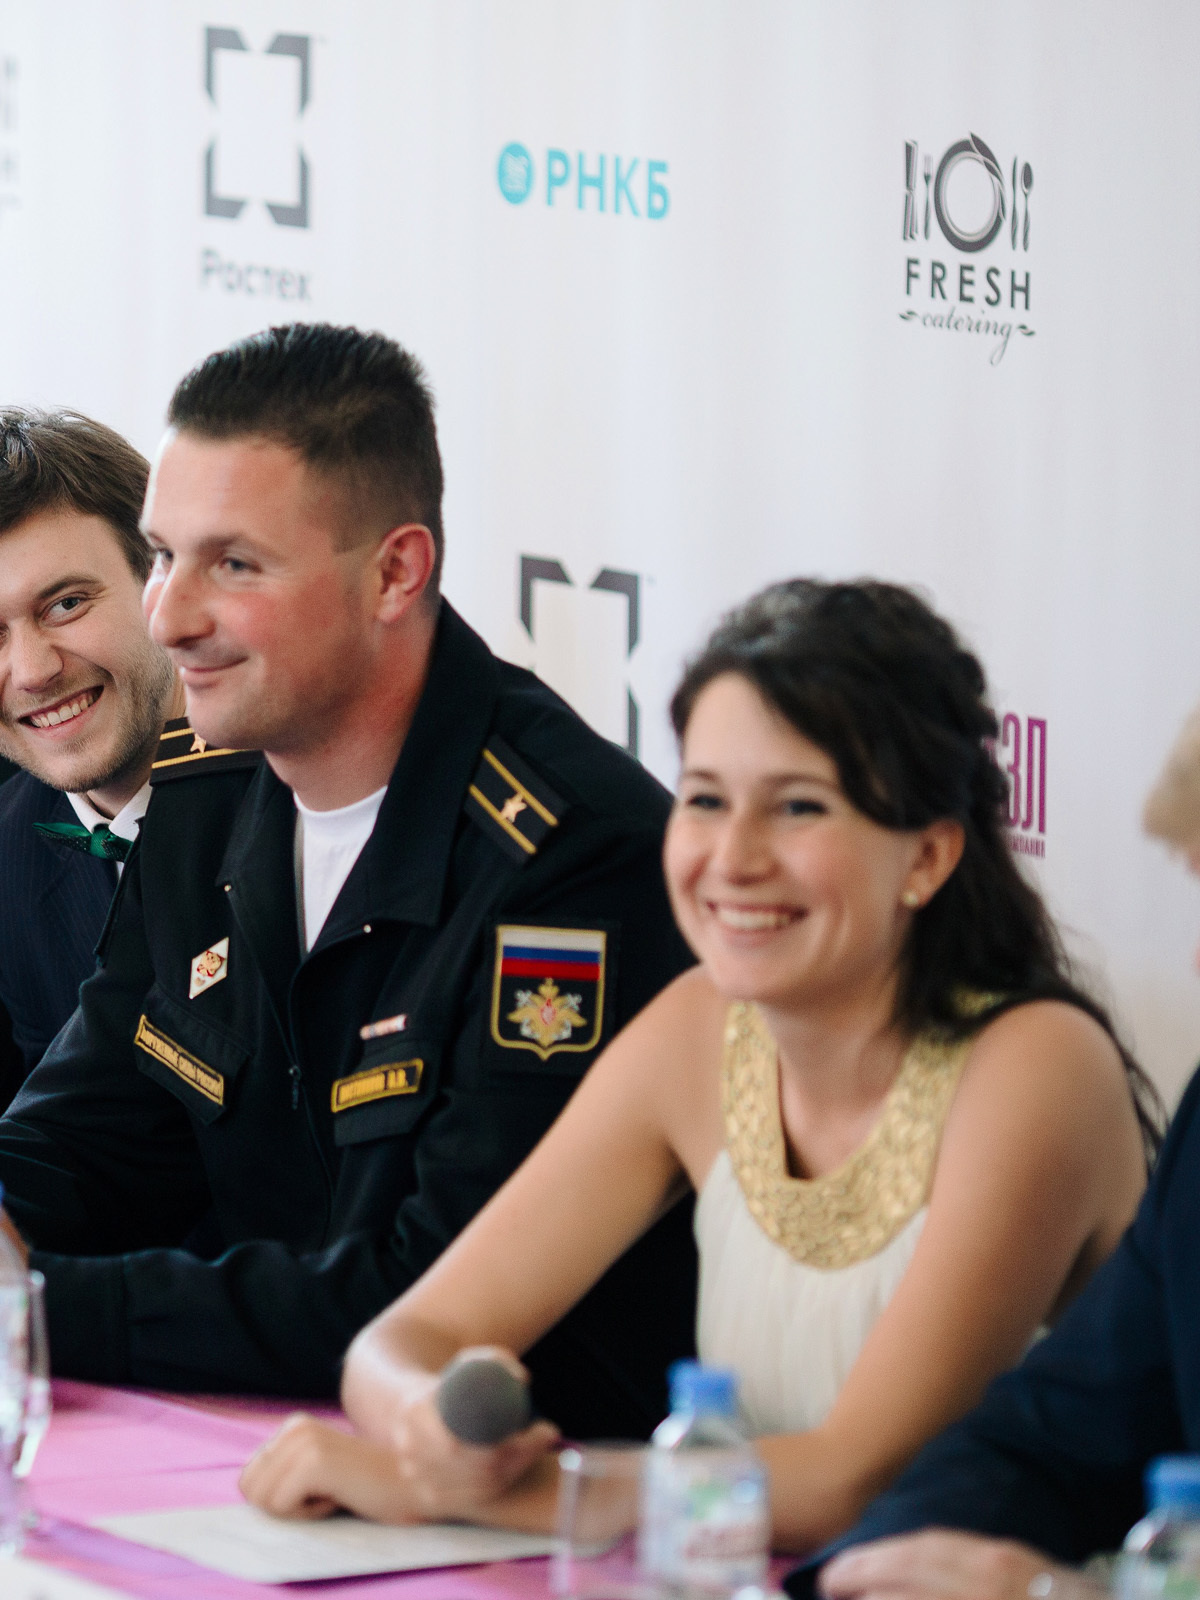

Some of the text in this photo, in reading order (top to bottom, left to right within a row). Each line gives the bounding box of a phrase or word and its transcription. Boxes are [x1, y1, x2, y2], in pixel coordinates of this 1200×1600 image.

[544, 148, 670, 220] РНКБ
[199, 247, 313, 302] Ростех
[905, 257, 1032, 312] FRESH
[920, 306, 1016, 367] catering
